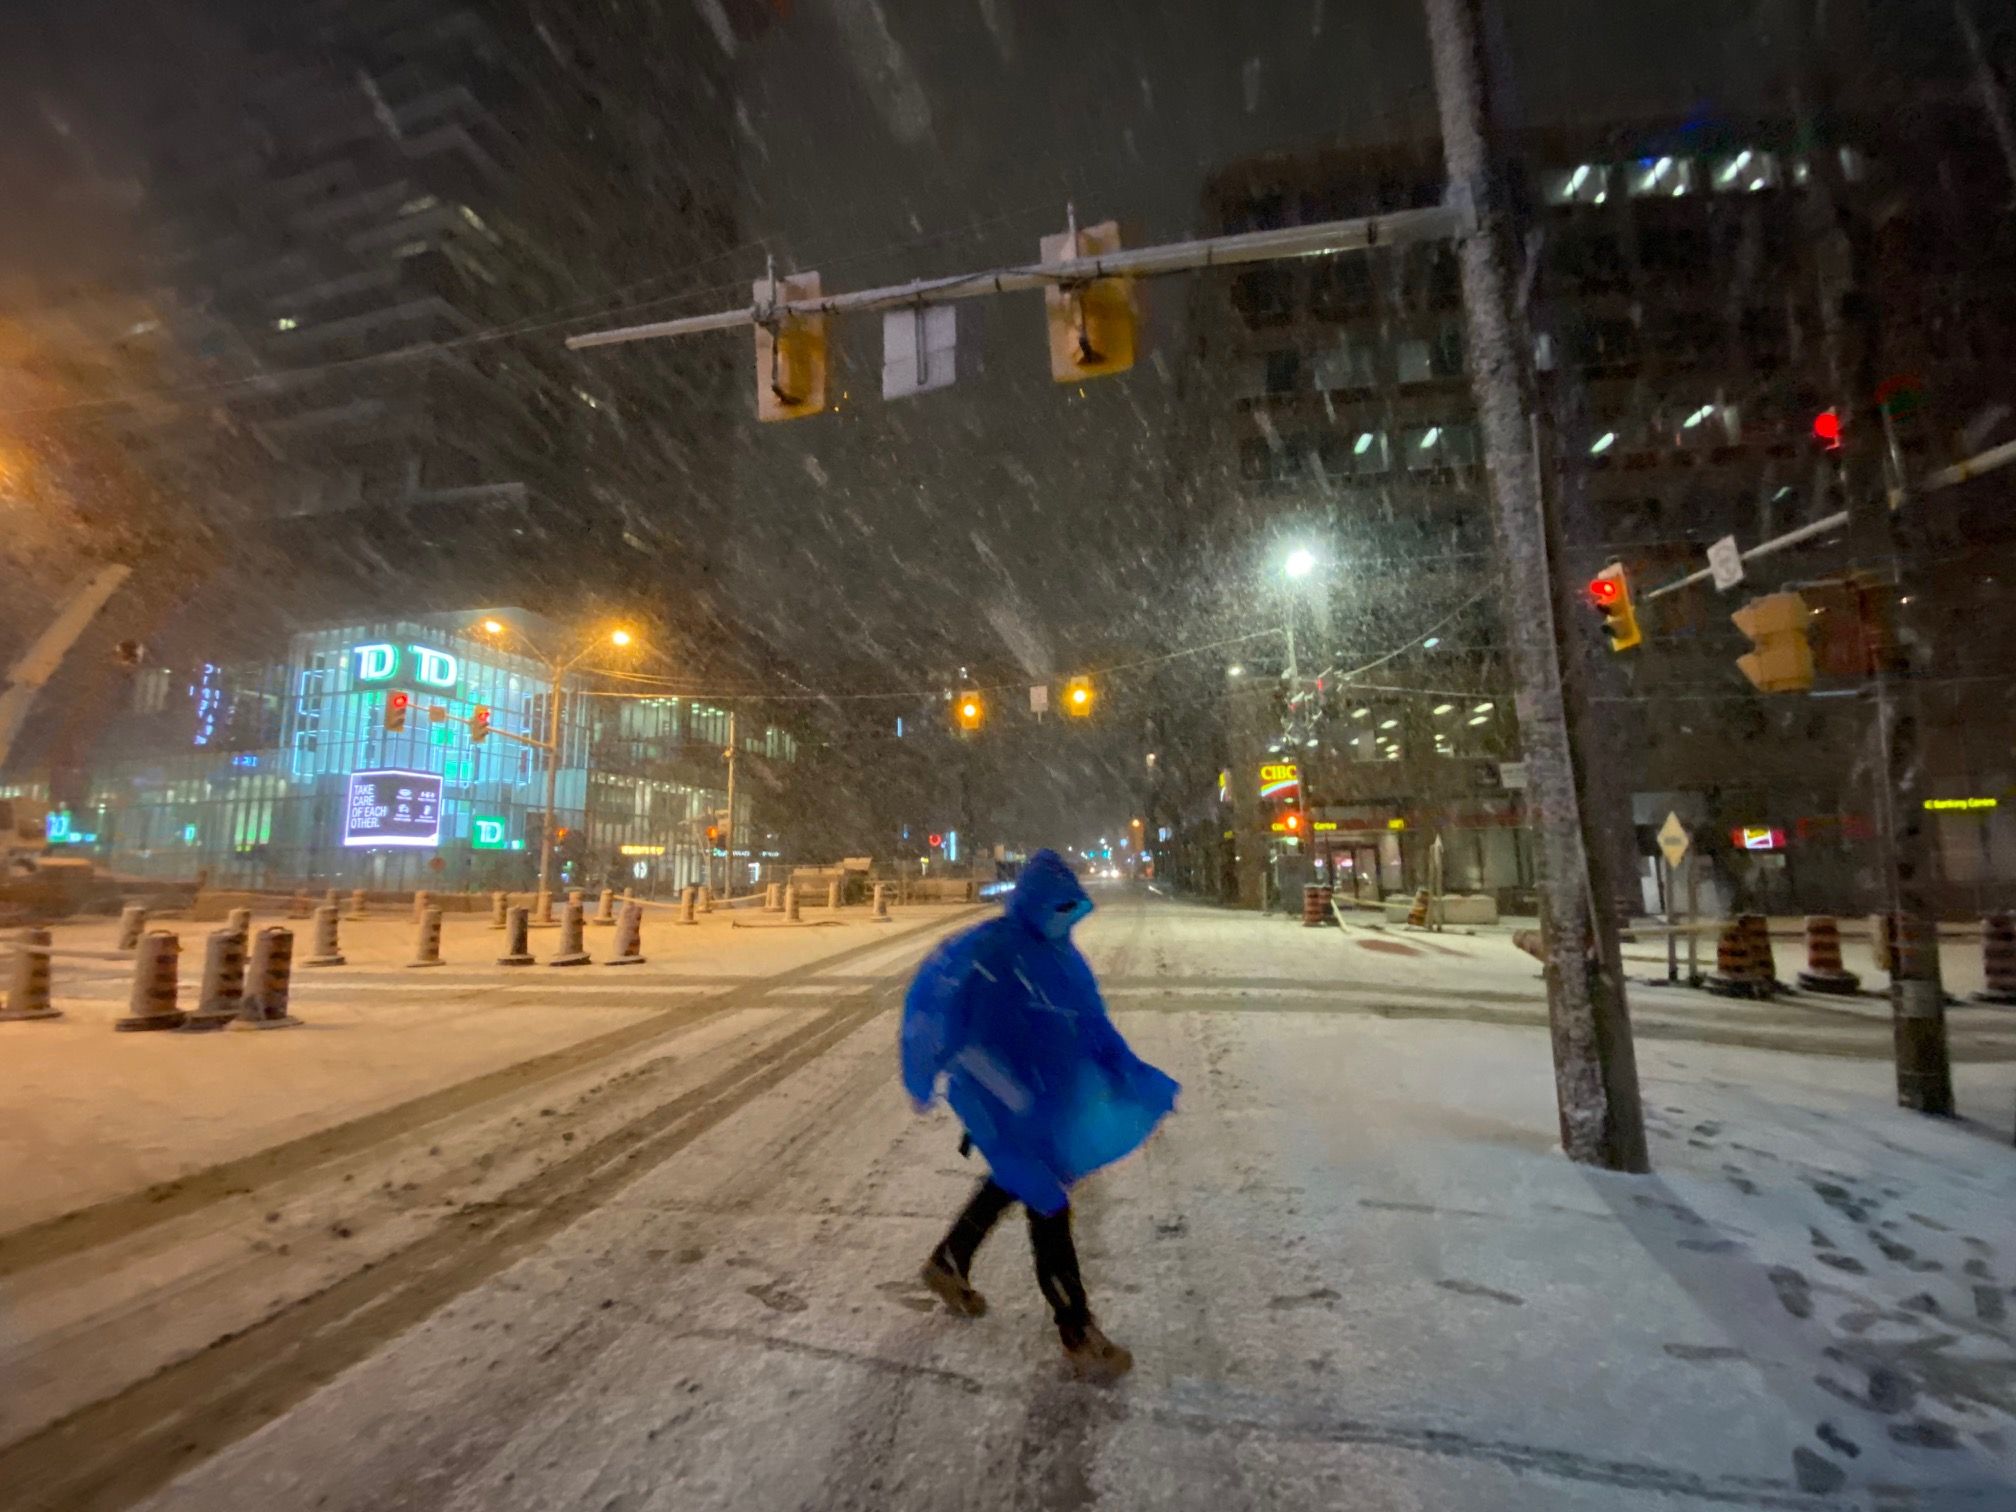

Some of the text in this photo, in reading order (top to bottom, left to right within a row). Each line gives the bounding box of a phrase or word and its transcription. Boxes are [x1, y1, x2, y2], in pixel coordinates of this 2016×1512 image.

[354, 644, 398, 681] TD
[409, 645, 457, 687] TD
[1260, 765, 1297, 780] CIBC
[354, 784, 376, 795] TAKE
[352, 795, 375, 806] CARE
[352, 805, 388, 817] OF EACH
[351, 817, 381, 829] OTHER.
[476, 820, 503, 843] TD
